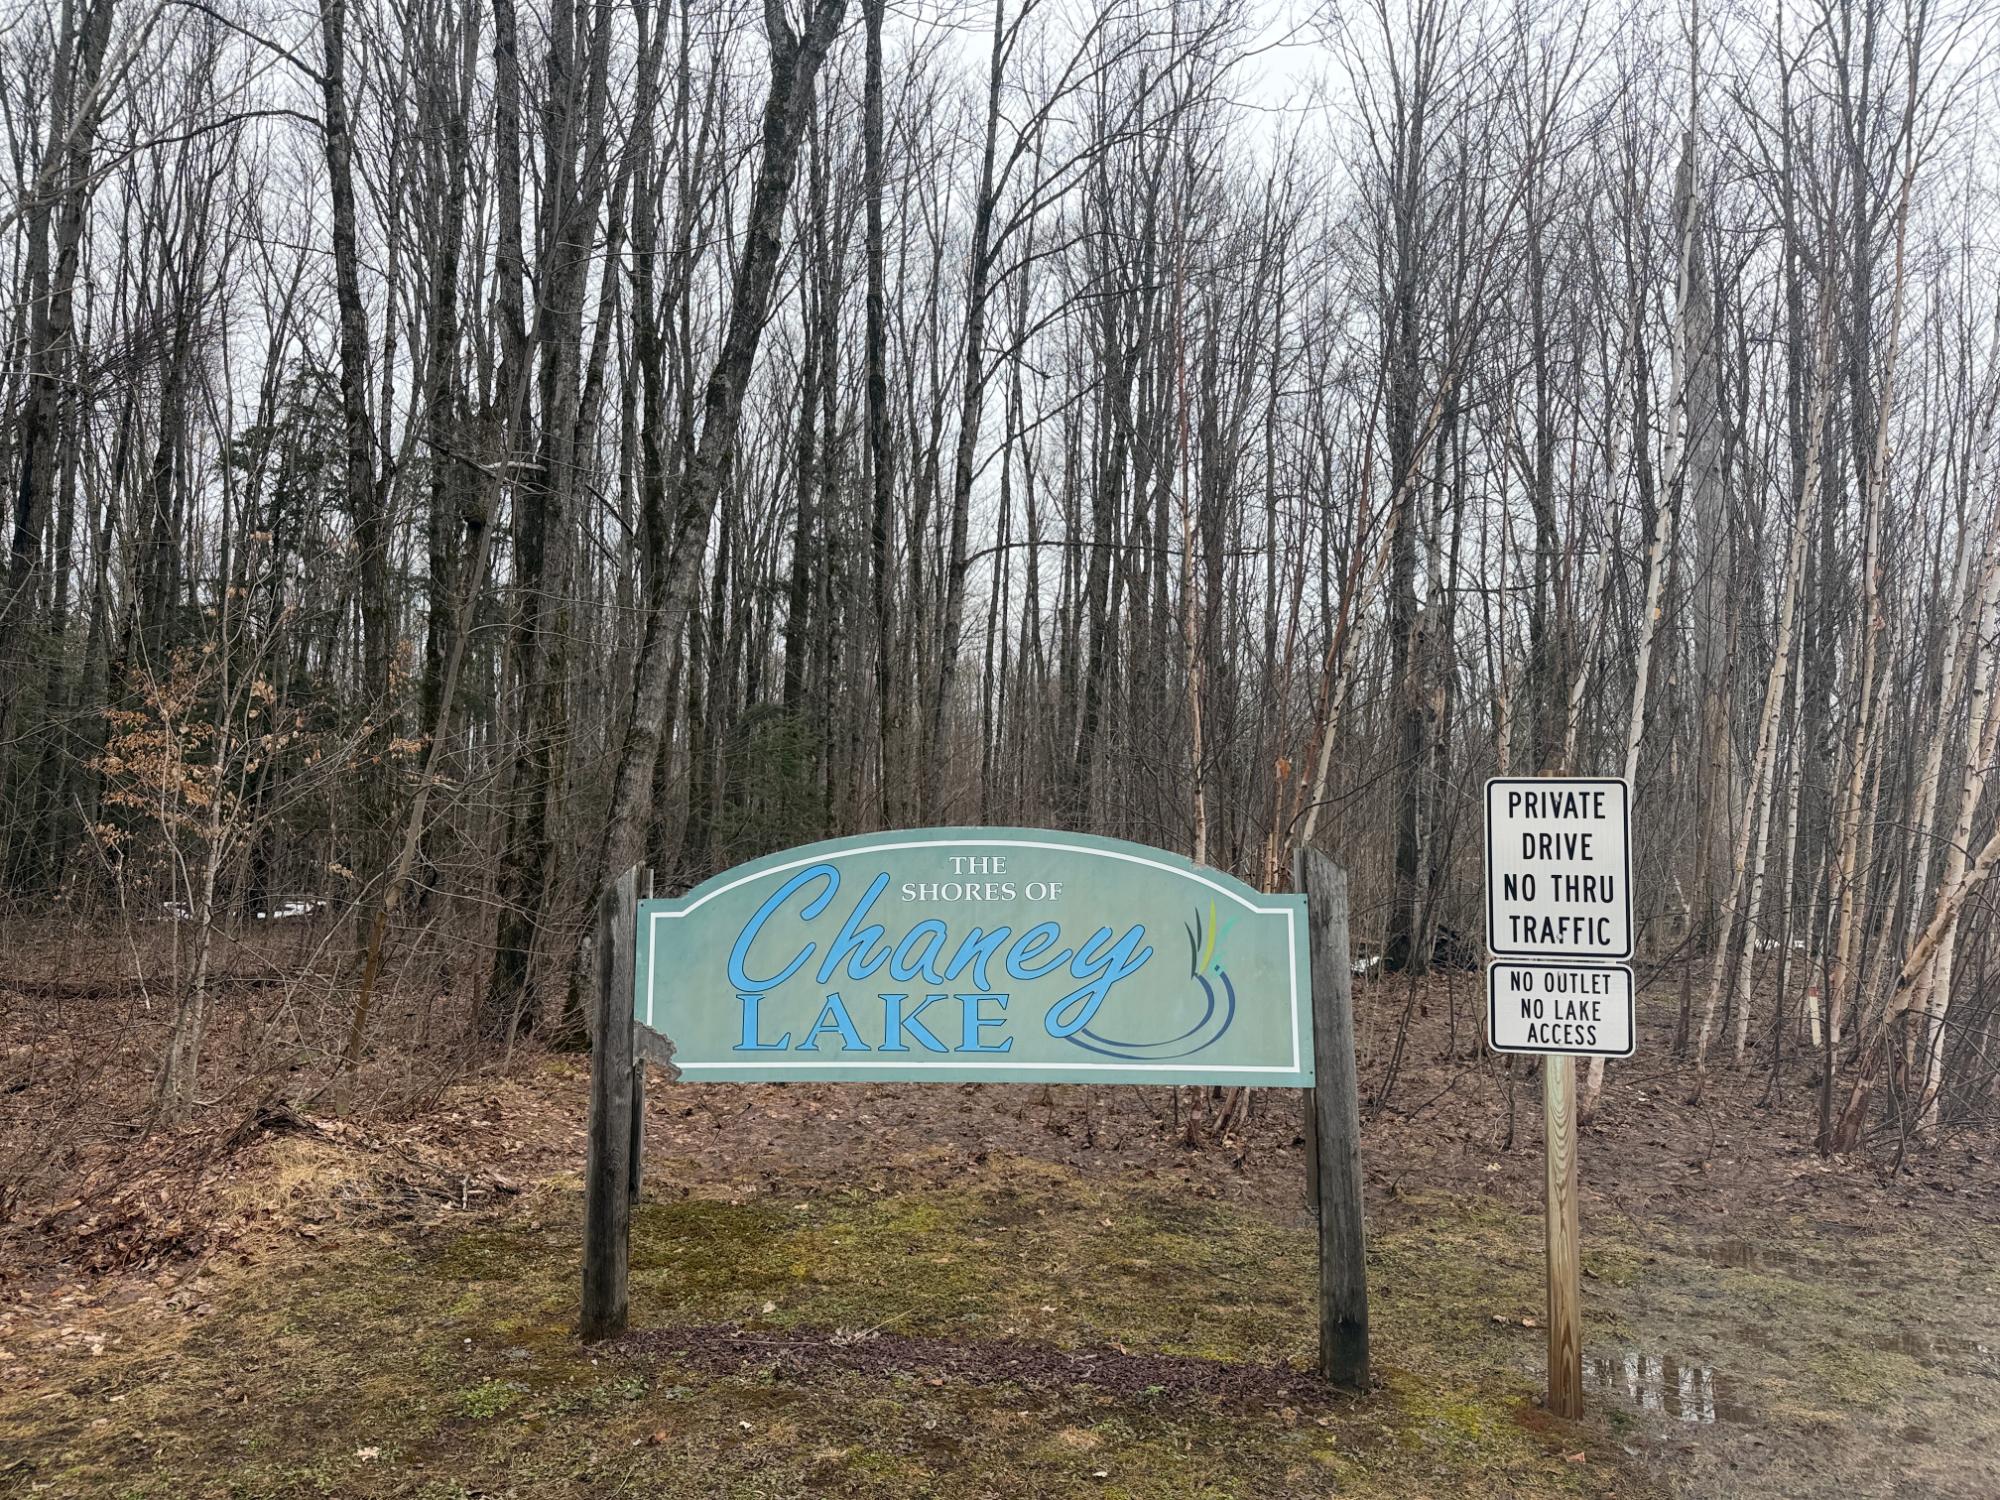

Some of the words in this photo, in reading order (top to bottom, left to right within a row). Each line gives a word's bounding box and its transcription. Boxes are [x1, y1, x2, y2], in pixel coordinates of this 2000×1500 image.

[1508, 791, 1606, 820] PRIVATE
[1522, 833, 1594, 861] DRIVE
[949, 856, 1006, 875] THE
[901, 881, 1017, 902] SHORES
[1024, 881, 1063, 901] OF
[1504, 873, 1537, 901] NO
[1551, 874, 1615, 904] THRU
[1509, 915, 1612, 946] TRAFFIC
[727, 863, 1154, 1039] Chaney
[1510, 971, 1534, 992] NO
[1544, 972, 1611, 995] OUTLET
[732, 992, 1014, 1053] LAKE
[1521, 998, 1544, 1019] NO
[1554, 1000, 1602, 1022] LAKE
[1527, 1023, 1597, 1046] ACCESS
